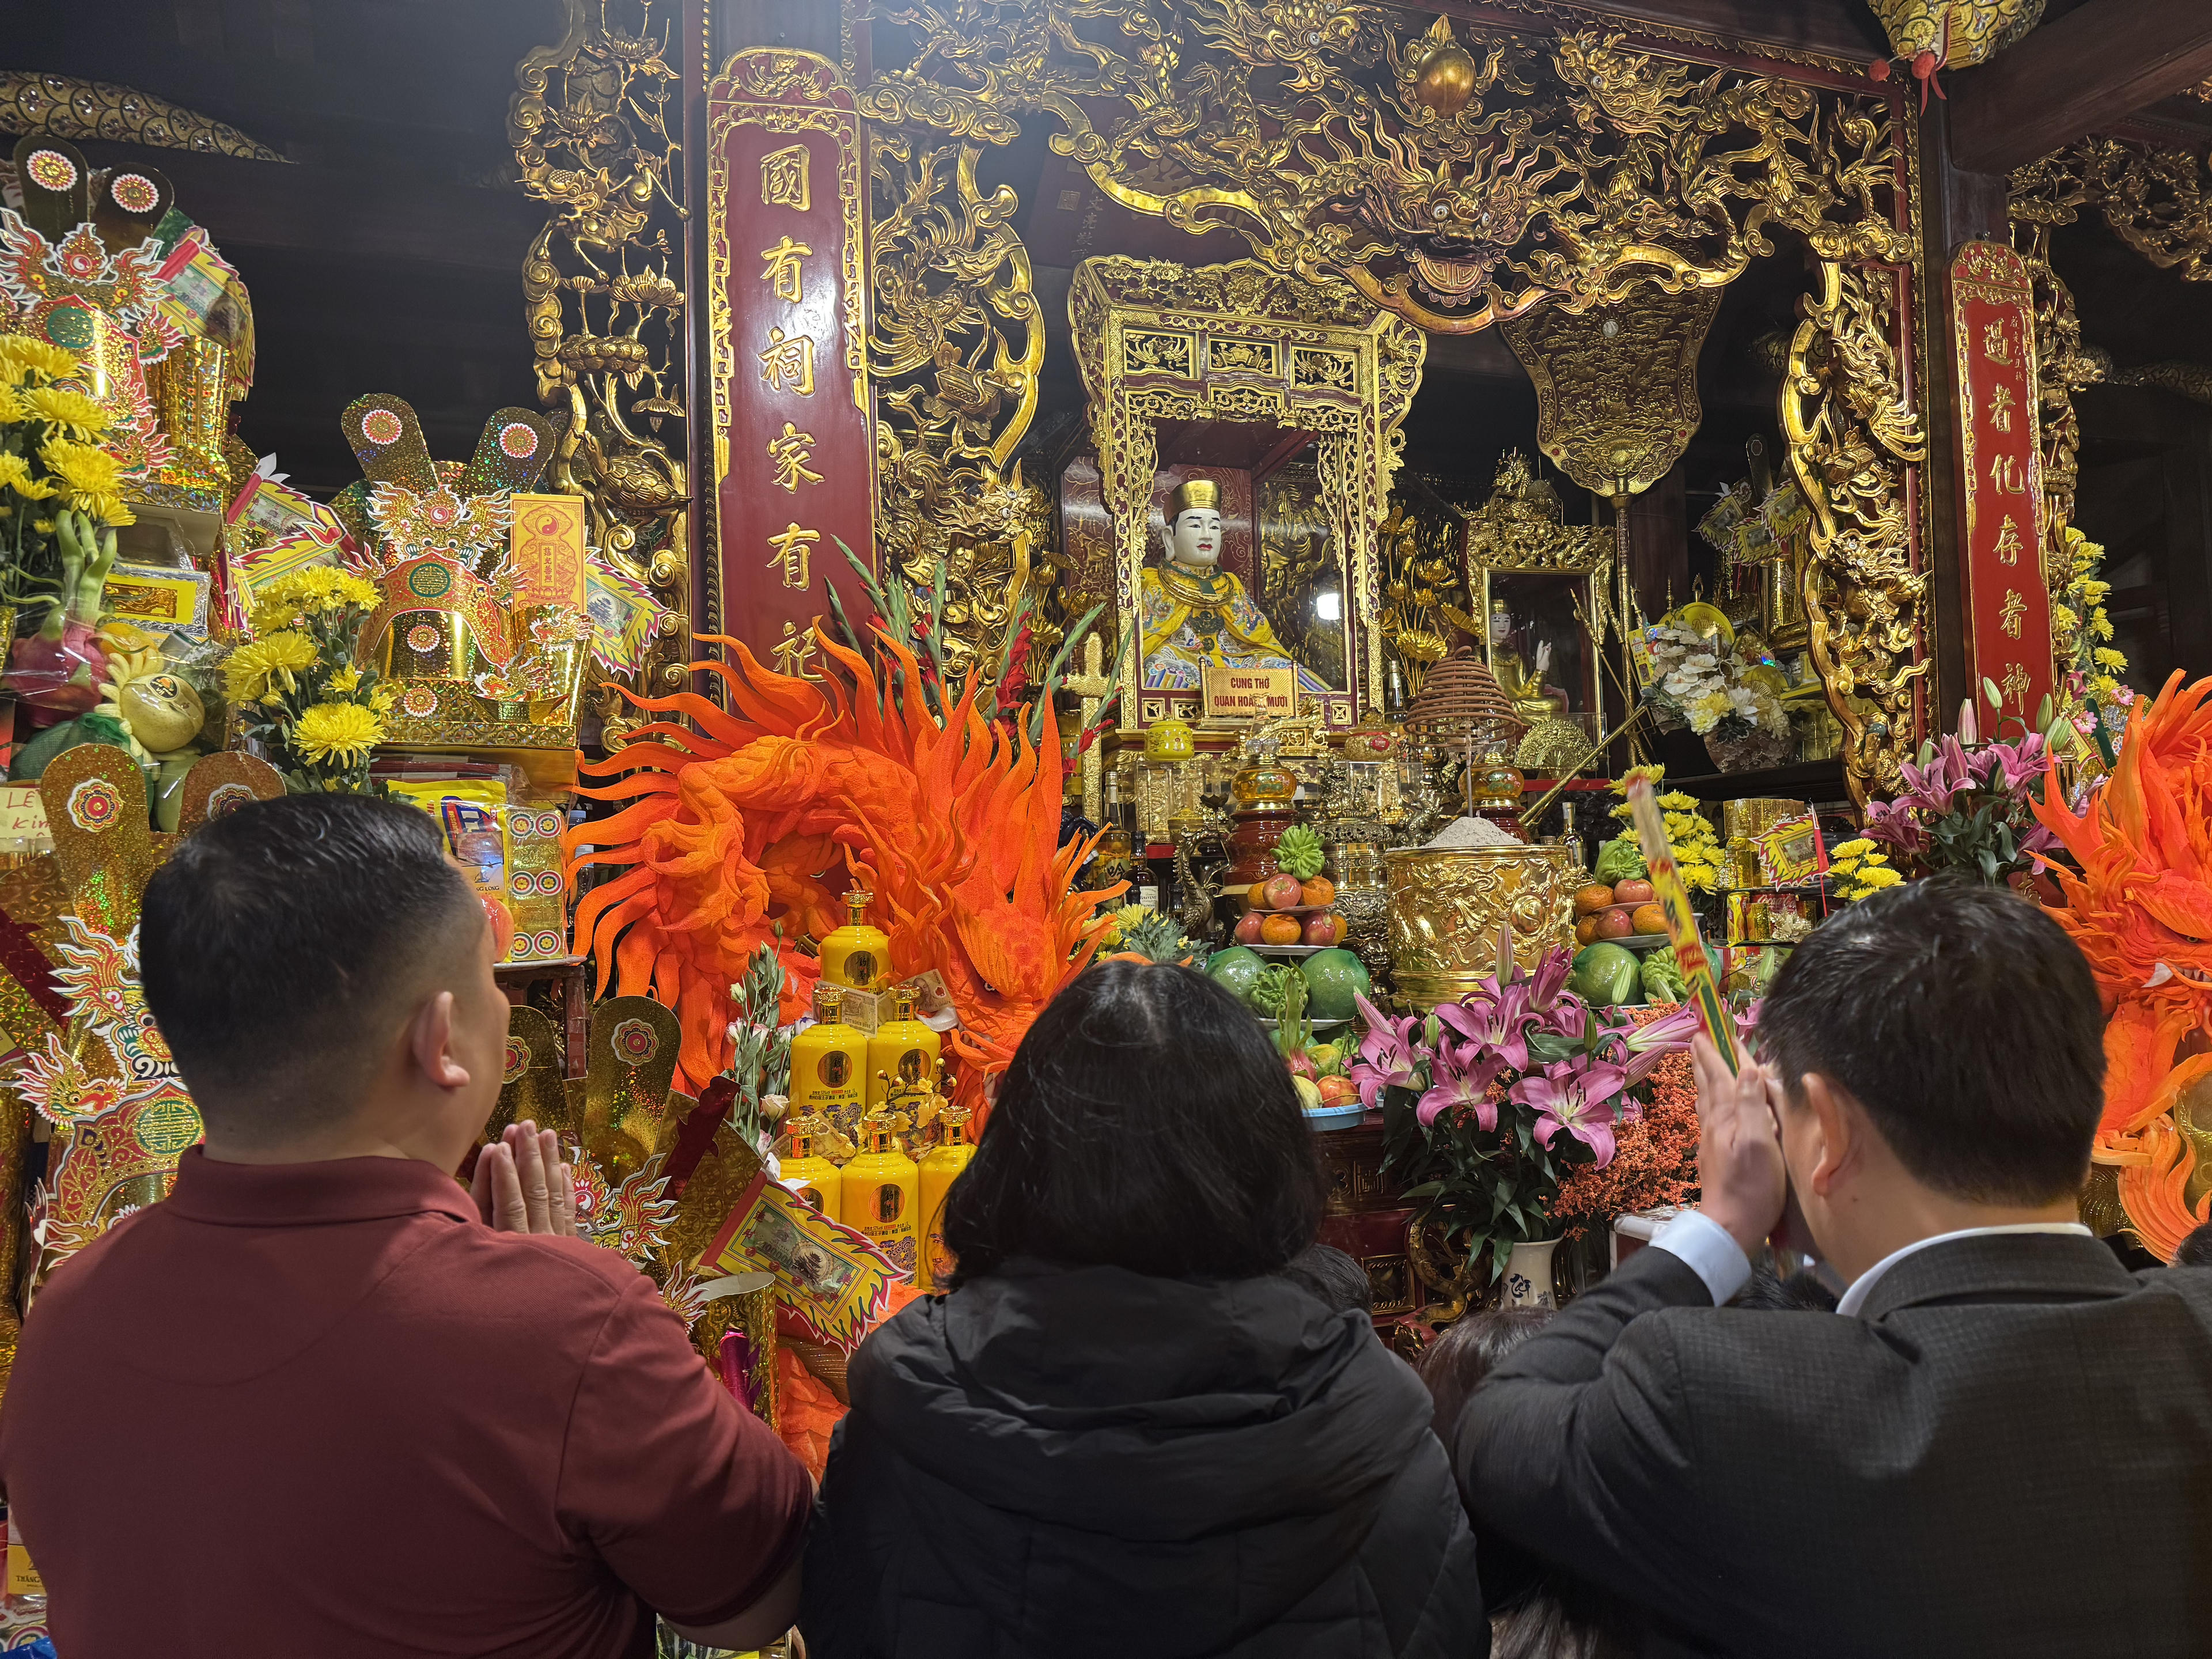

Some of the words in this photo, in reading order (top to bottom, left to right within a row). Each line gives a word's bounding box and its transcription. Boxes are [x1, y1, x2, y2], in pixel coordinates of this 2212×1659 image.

[1230, 677, 1253, 689] CUNG
[1254, 676, 1270, 689] THỜ
[1214, 695, 1236, 707] QUAN
[1267, 694, 1288, 707] MƯỜI
